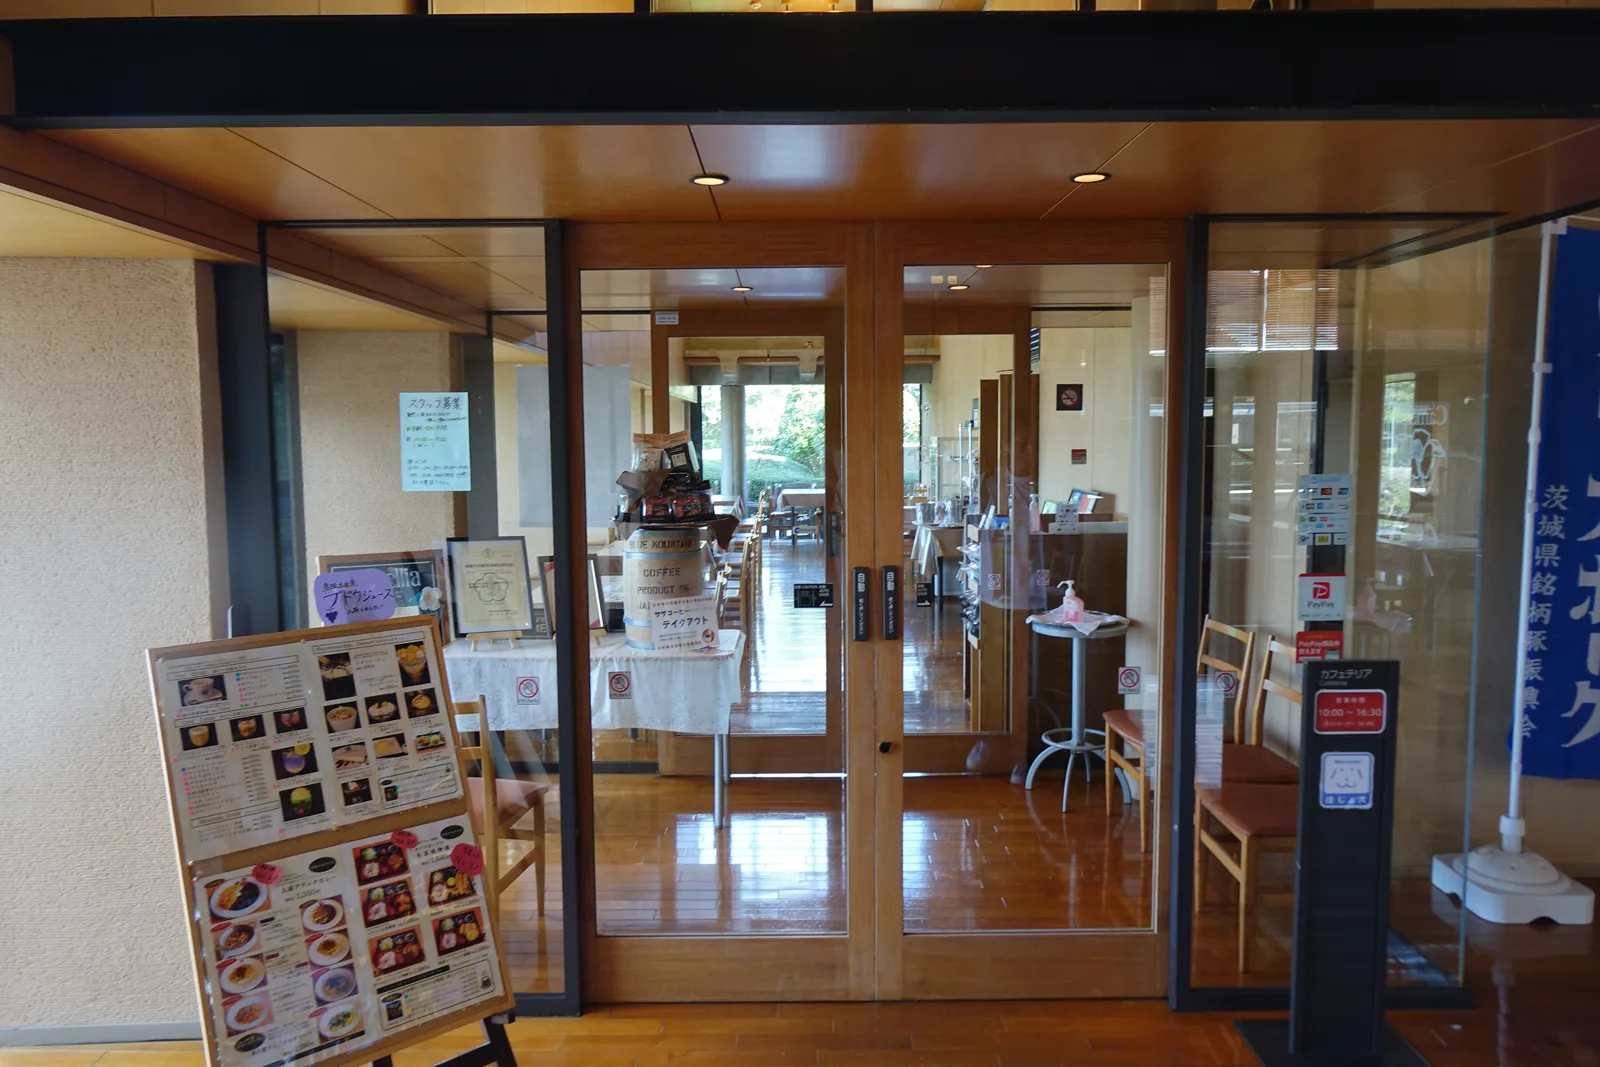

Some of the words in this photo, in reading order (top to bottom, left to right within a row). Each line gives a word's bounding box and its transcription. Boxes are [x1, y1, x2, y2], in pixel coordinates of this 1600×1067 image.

[629, 541, 648, 549] BLUE
[652, 540, 693, 549] MOUNTAIN
[643, 568, 681, 577] COFFEE
[637, 586, 675, 595] PRODUCT
[1307, 601, 1335, 609] PayPay
[662, 616, 708, 629] テイクアウト
[1320, 668, 1373, 679] カフェテリア
[1318, 708, 1344, 717] 10:00
[1356, 708, 1382, 717] 16:30
